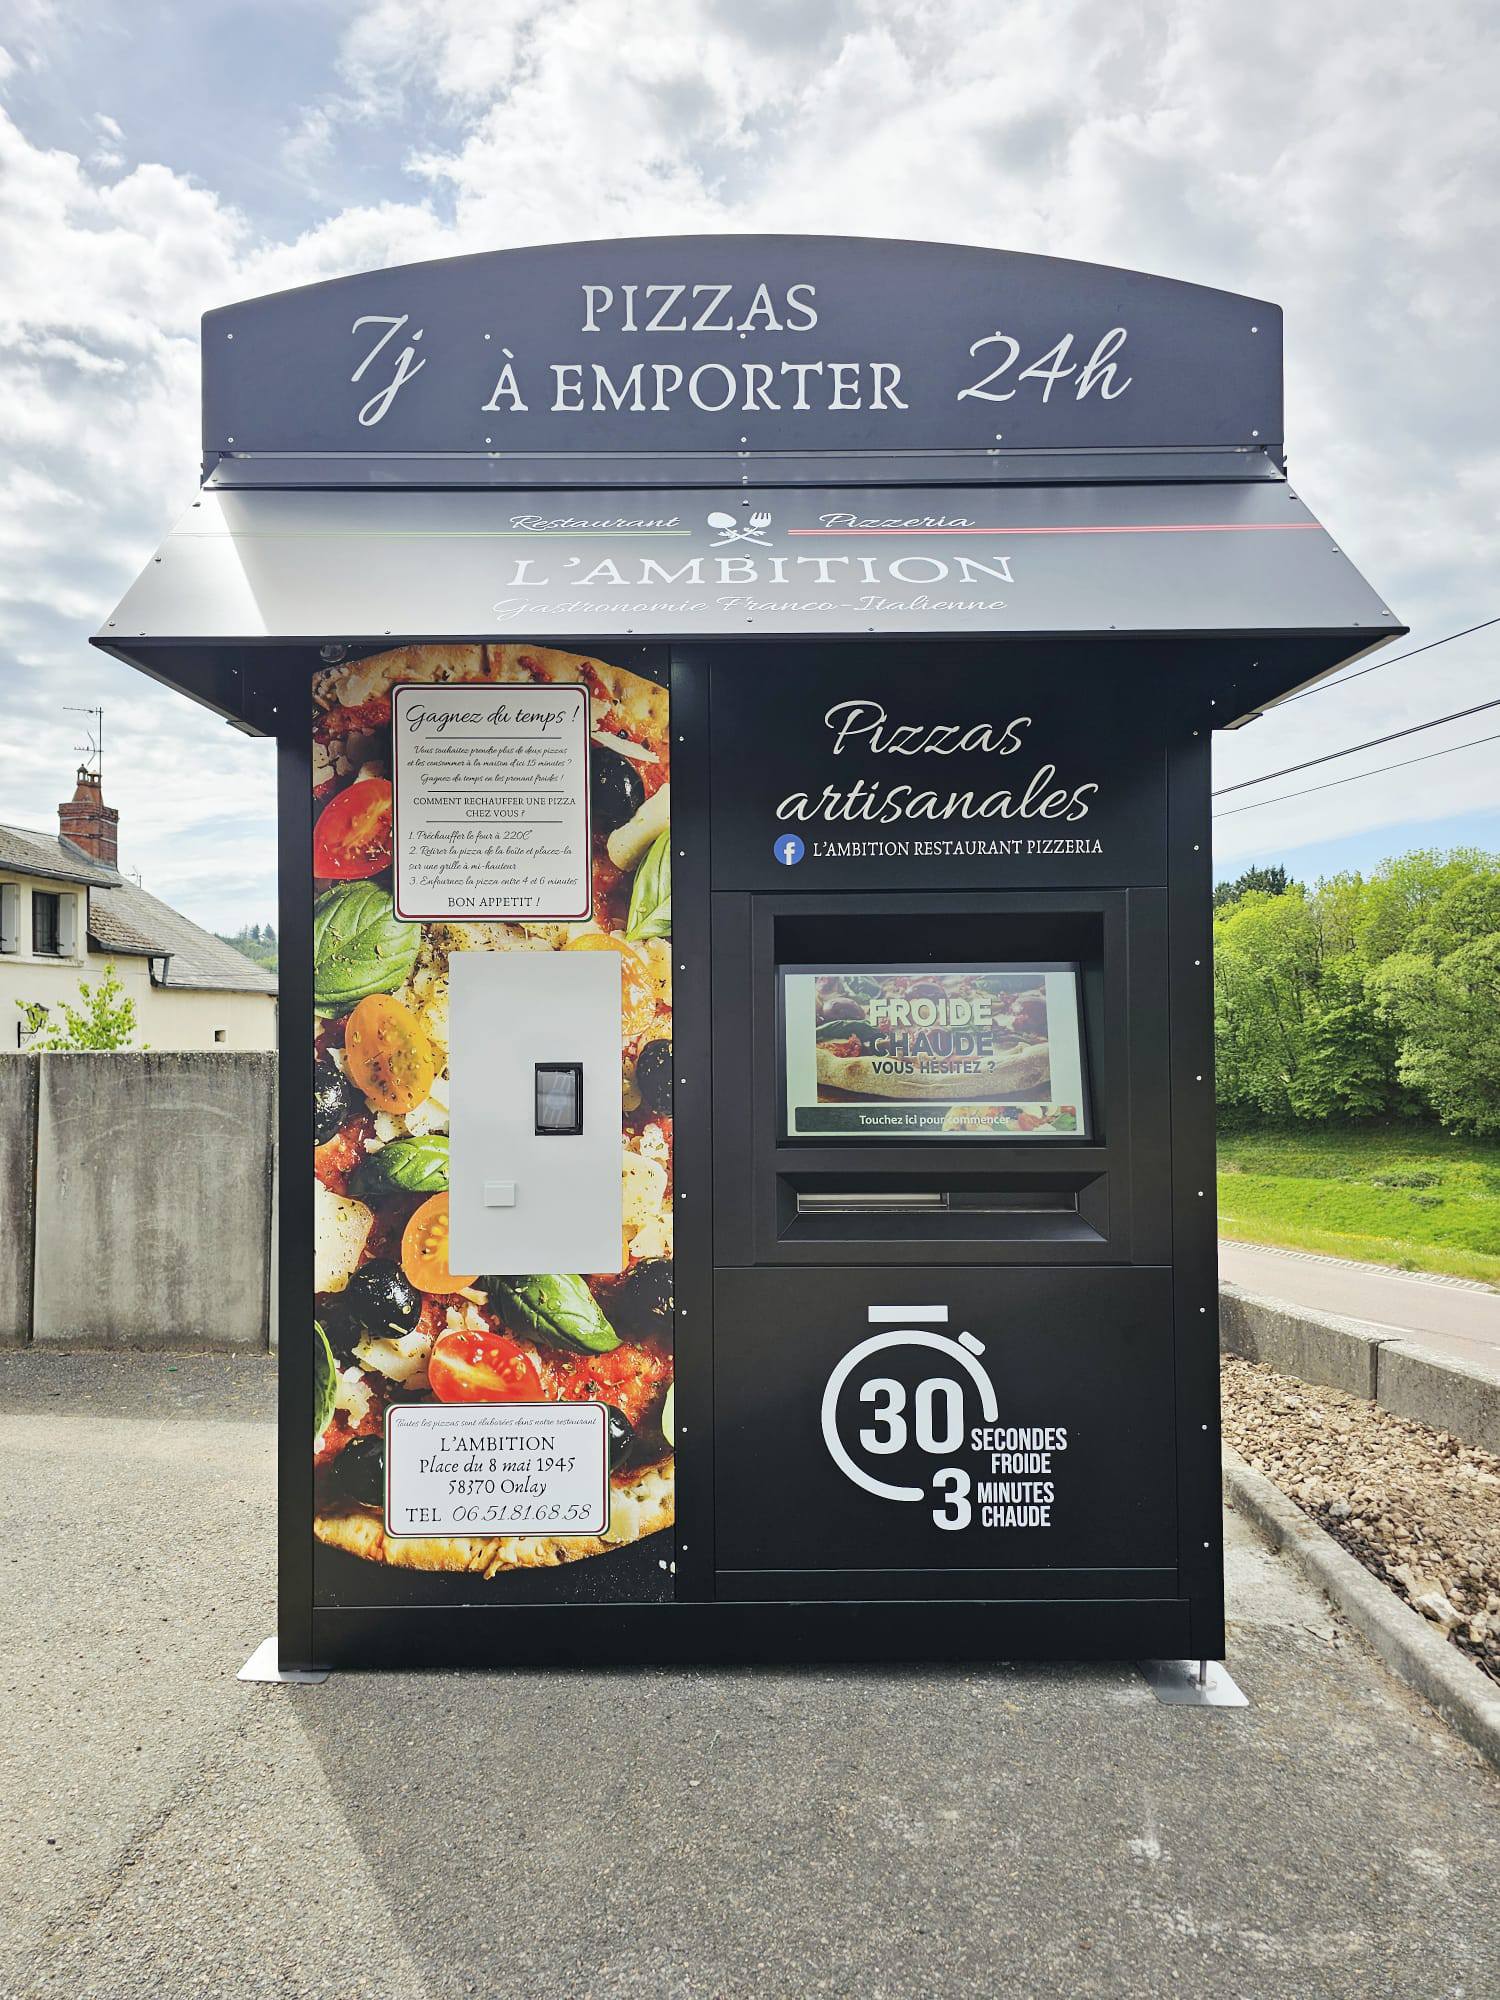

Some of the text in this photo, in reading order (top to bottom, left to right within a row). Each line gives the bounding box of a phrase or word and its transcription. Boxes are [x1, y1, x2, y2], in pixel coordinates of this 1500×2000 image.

[582, 284, 818, 332] PIZZAS
[350, 313, 426, 427] 7j
[957, 327, 1132, 403] 24h
[481, 348, 909, 412] À EMPORTER
[510, 515, 680, 531] Restaurant
[819, 513, 975, 528] Pizzeria
[506, 556, 1015, 586] L'AMBITION
[491, 595, 1008, 621] Gastronomie Franco-Italienne
[405, 704, 580, 732] Gagnez du temps !
[824, 700, 1032, 755] Pizzas
[413, 745, 568, 757] Vous souhaitez prendre plus de deux pizzas
[414, 758, 426, 767] les
[473, 758, 481, 767] la
[537, 759, 566, 767] minutes
[420, 773, 451, 785] Gagnez
[452, 773, 462, 783] du
[463, 775, 483, 785] temps
[494, 773, 504, 782] les
[504, 775, 534, 785] prenant
[413, 797, 577, 806] COMMENT RECHAUFFER UNE PIZZA
[775, 764, 1099, 824] artisanales
[465, 809, 491, 818] CHEZ
[493, 809, 519, 818] VOUS
[416, 830, 465, 843] Préchauffer
[466, 830, 474, 840] le
[475, 830, 493, 844] four
[495, 831, 501, 840] à
[419, 845, 448, 856] Retirer
[448, 845, 458, 855] la
[458, 847, 483, 858] pizza
[484, 845, 493, 856] de
[494, 845, 504, 855] la
[527, 847, 534, 855] et
[533, 845, 572, 858] placez-la
[813, 841, 911, 857] L'AMBITION
[914, 840, 1023, 856] RESTAURANT
[1027, 839, 1103, 855] PIZZERIA
[439, 861, 462, 874] grille
[463, 862, 469, 870] à
[470, 861, 517, 870] mi-hauteur
[419, 876, 463, 888] Enfournez
[465, 876, 475, 885] la
[474, 878, 499, 888] pizza
[500, 876, 521, 885] entre
[522, 876, 529, 885] 4
[530, 876, 538, 885] et
[539, 876, 546, 885] 6
[547, 877, 579, 885] minutes
[447, 897, 541, 907] BON APPETIT !
[868, 998, 993, 1027] FROIDE
[874, 1030, 994, 1057] CHAUDE
[872, 1061, 914, 1074] VOUS
[987, 1060, 996, 1073] ?
[859, 1114, 1011, 1128] Touchez ici pour commencer
[395, 1418, 419, 1428] Toutes
[420, 1418, 432, 1427] les
[432, 1419, 460, 1429] pizzas
[460, 1419, 477, 1427] sont
[514, 1417, 534, 1427] dans
[556, 1417, 597, 1426] restaurant
[859, 1377, 1067, 1454] 30 SECONDES
[440, 1436, 556, 1452] L'AMBITION
[419, 1454, 576, 1473] Place du 8 mai 1945
[991, 1452, 1051, 1474] FROIDE
[448, 1474, 547, 1498] 58370 Onlay
[932, 1467, 1055, 1531] 3 MINUTES
[405, 1507, 442, 1523] TEL
[982, 1505, 1051, 1527] CHAUDE
